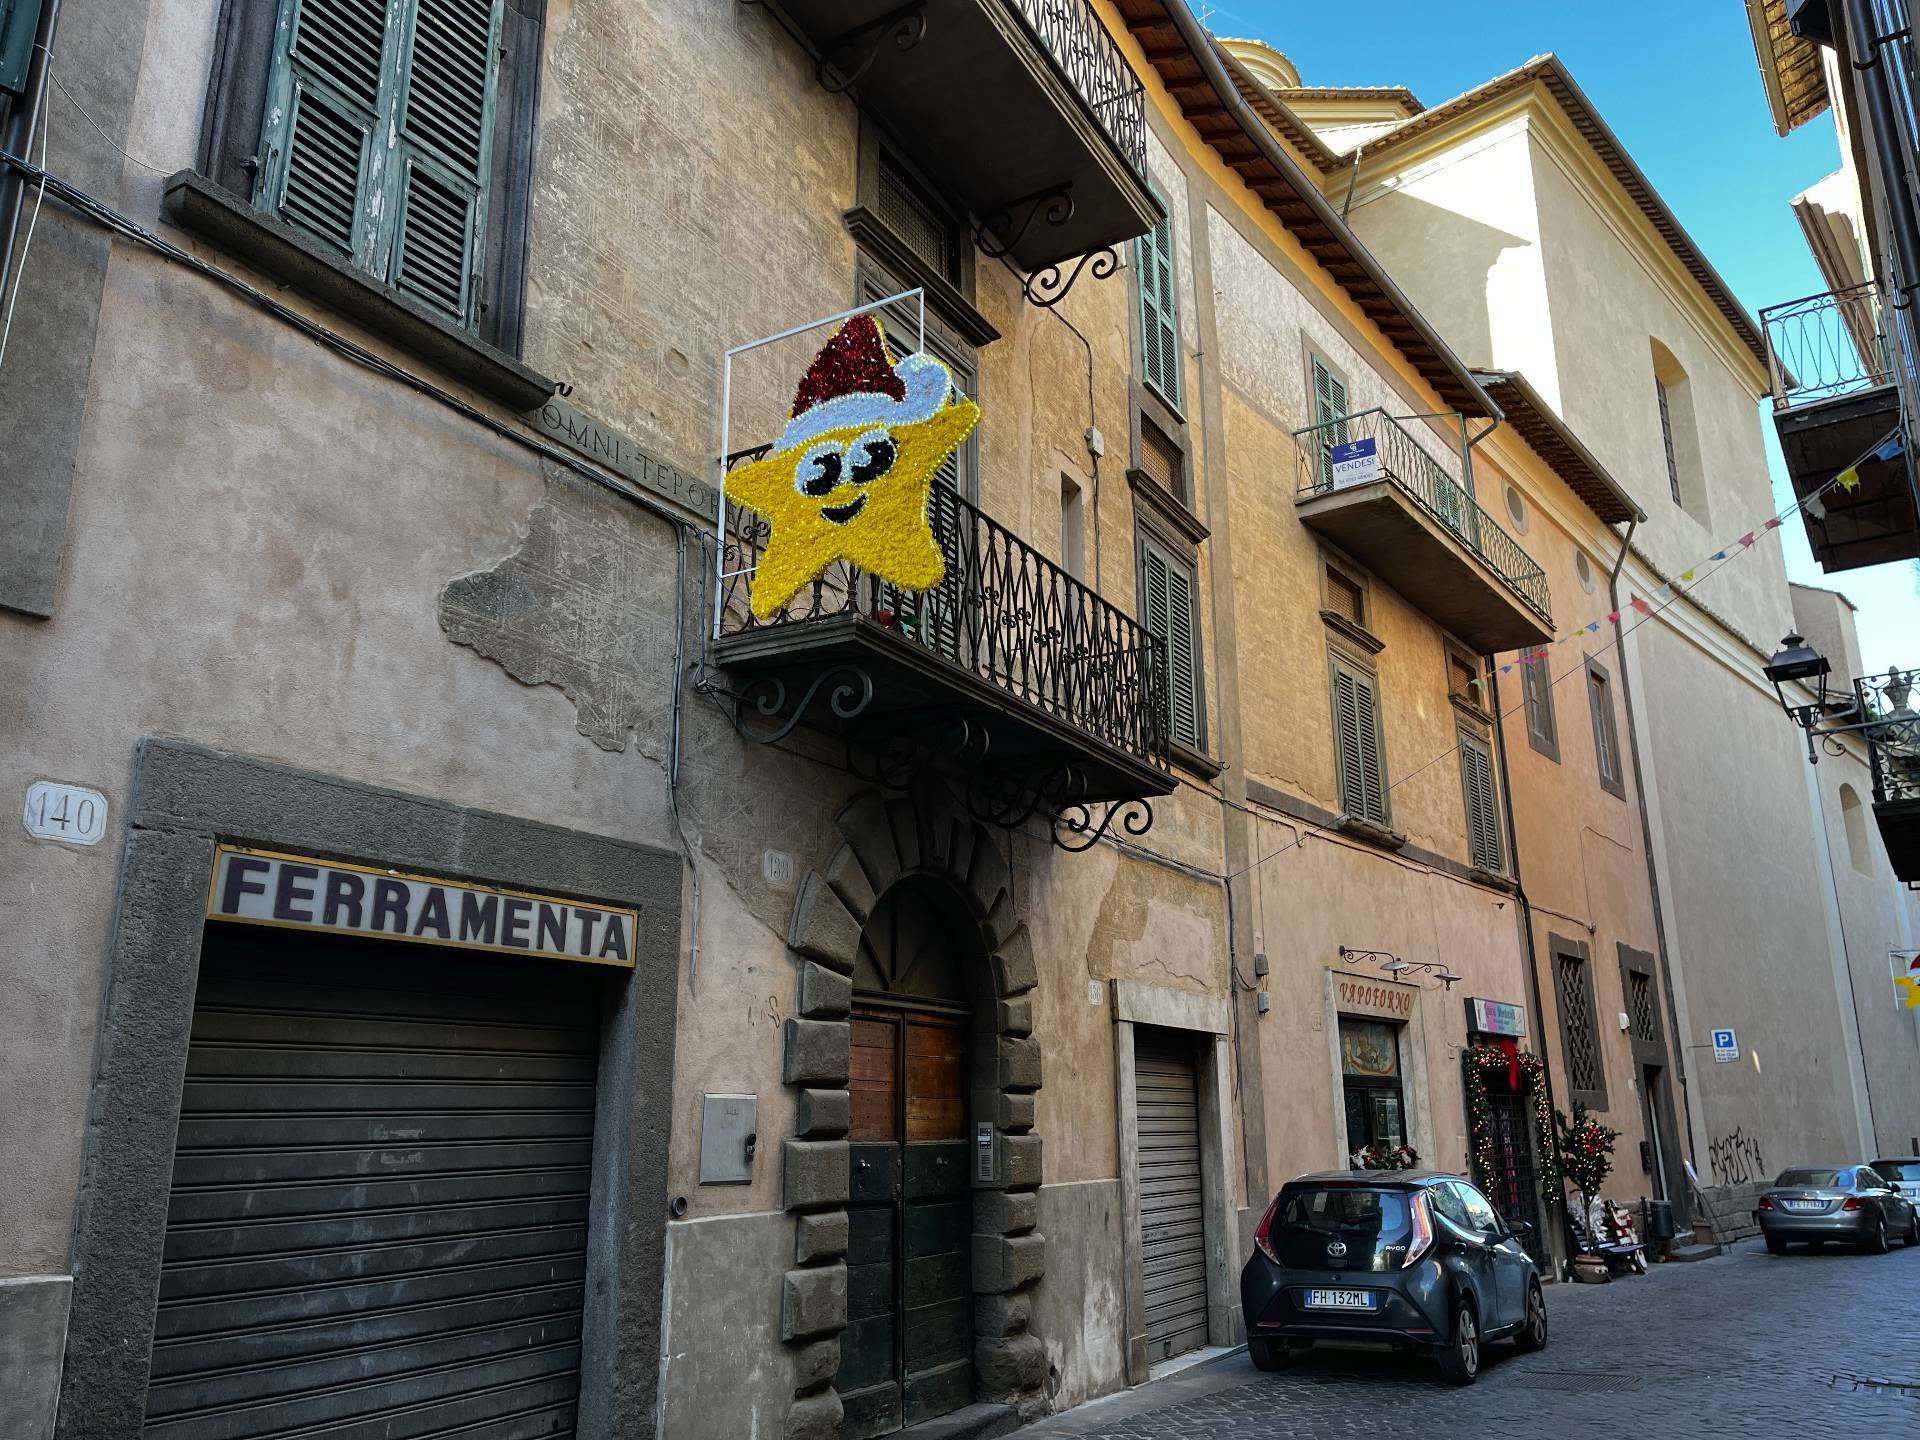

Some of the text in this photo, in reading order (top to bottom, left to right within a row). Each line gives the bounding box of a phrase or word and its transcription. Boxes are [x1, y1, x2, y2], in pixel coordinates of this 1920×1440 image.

[1334, 457, 1375, 473] VENDESI
[36, 791, 94, 834] 140
[221, 856, 628, 961] FERRAMENTA
[1340, 982, 1411, 1015] VAPOFORNO
[1718, 1033, 1730, 1046] P
[1312, 1290, 1368, 1306] FH 132ML
